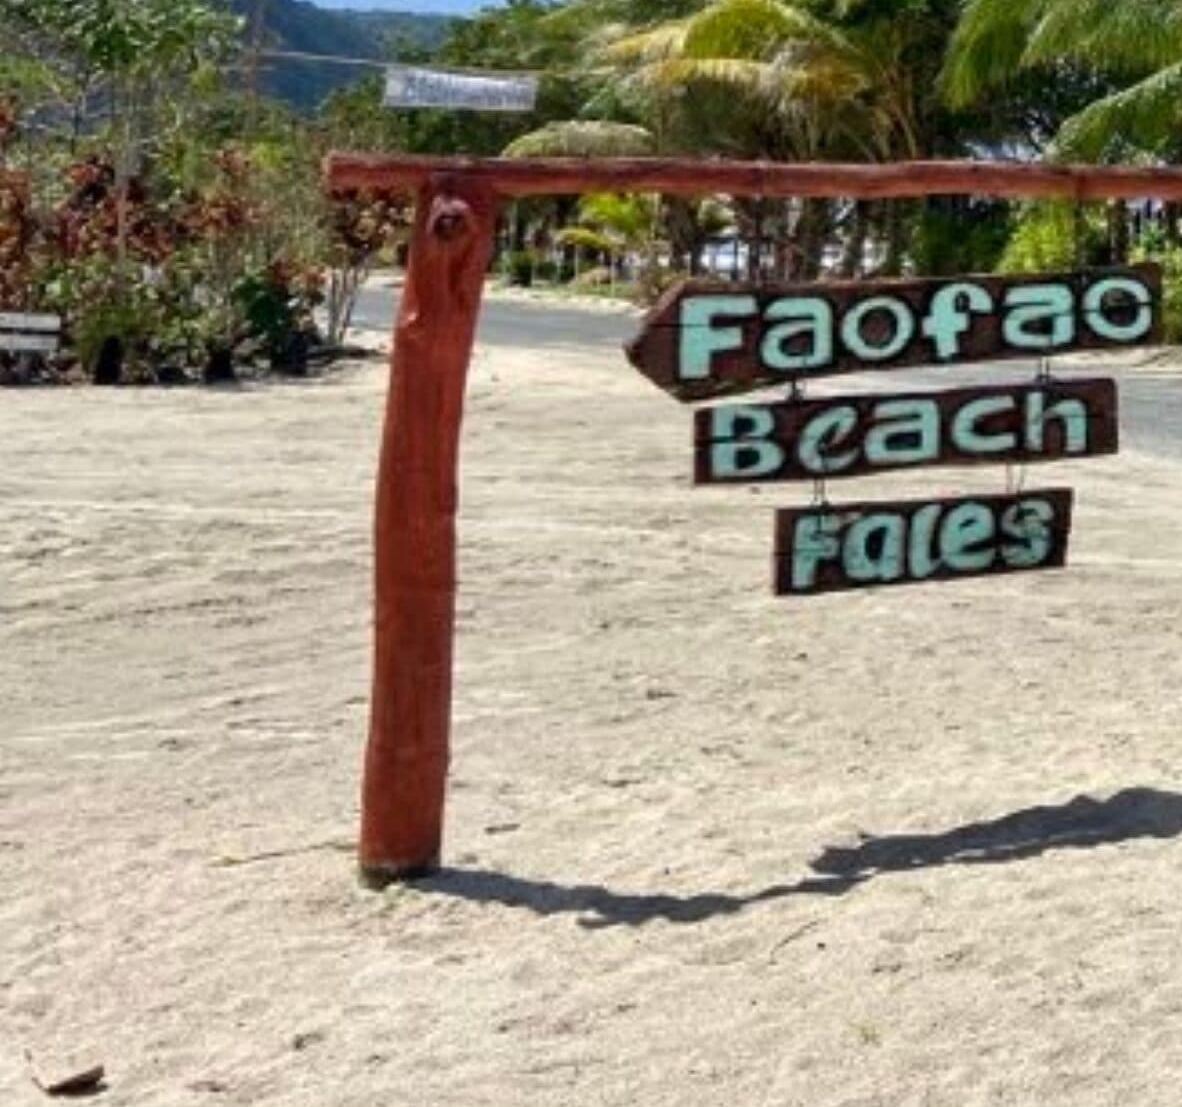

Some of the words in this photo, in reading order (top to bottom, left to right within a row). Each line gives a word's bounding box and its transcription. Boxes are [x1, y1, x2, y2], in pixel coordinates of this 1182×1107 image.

[677, 278, 1153, 379] Faofao
[710, 390, 1088, 479] Beach
[791, 498, 1056, 589] Fales
